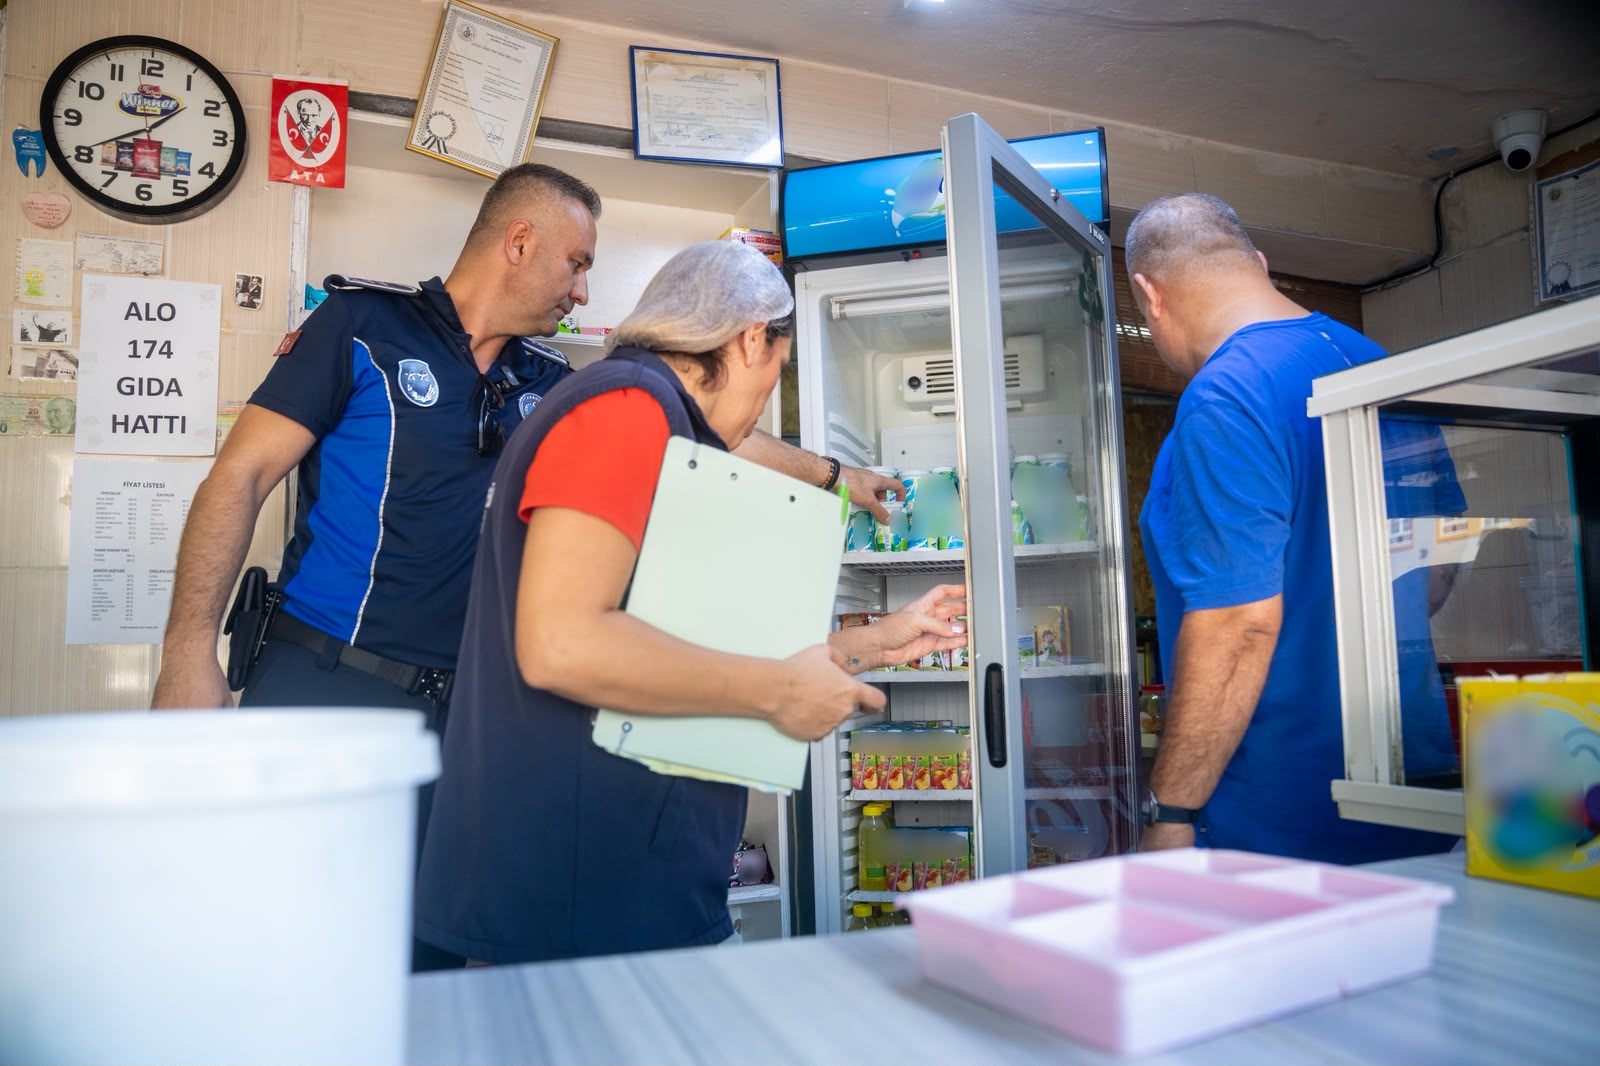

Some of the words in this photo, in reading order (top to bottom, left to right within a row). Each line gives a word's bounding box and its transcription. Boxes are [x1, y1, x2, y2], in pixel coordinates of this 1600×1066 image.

[110, 63, 124, 82] 11
[141, 58, 164, 78] 12
[78, 80, 105, 101] 10
[186, 75, 192, 91] 1
[121, 92, 179, 110] Winner
[203, 99, 221, 117] 2
[64, 109, 83, 126] 9
[212, 129, 228, 147] 3
[75, 146, 94, 164] 8
[101, 170, 118, 188] 7
[198, 161, 216, 179] 4
[290, 169, 325, 183] ATA
[135, 183, 153, 201] 6
[172, 179, 189, 197] 5
[124, 301, 176, 322] ALO
[127, 339, 174, 359] 174
[116, 376, 183, 397] GIDA
[112, 414, 187, 434] HATTI
[143, 481, 166, 489] LİSTESİ
